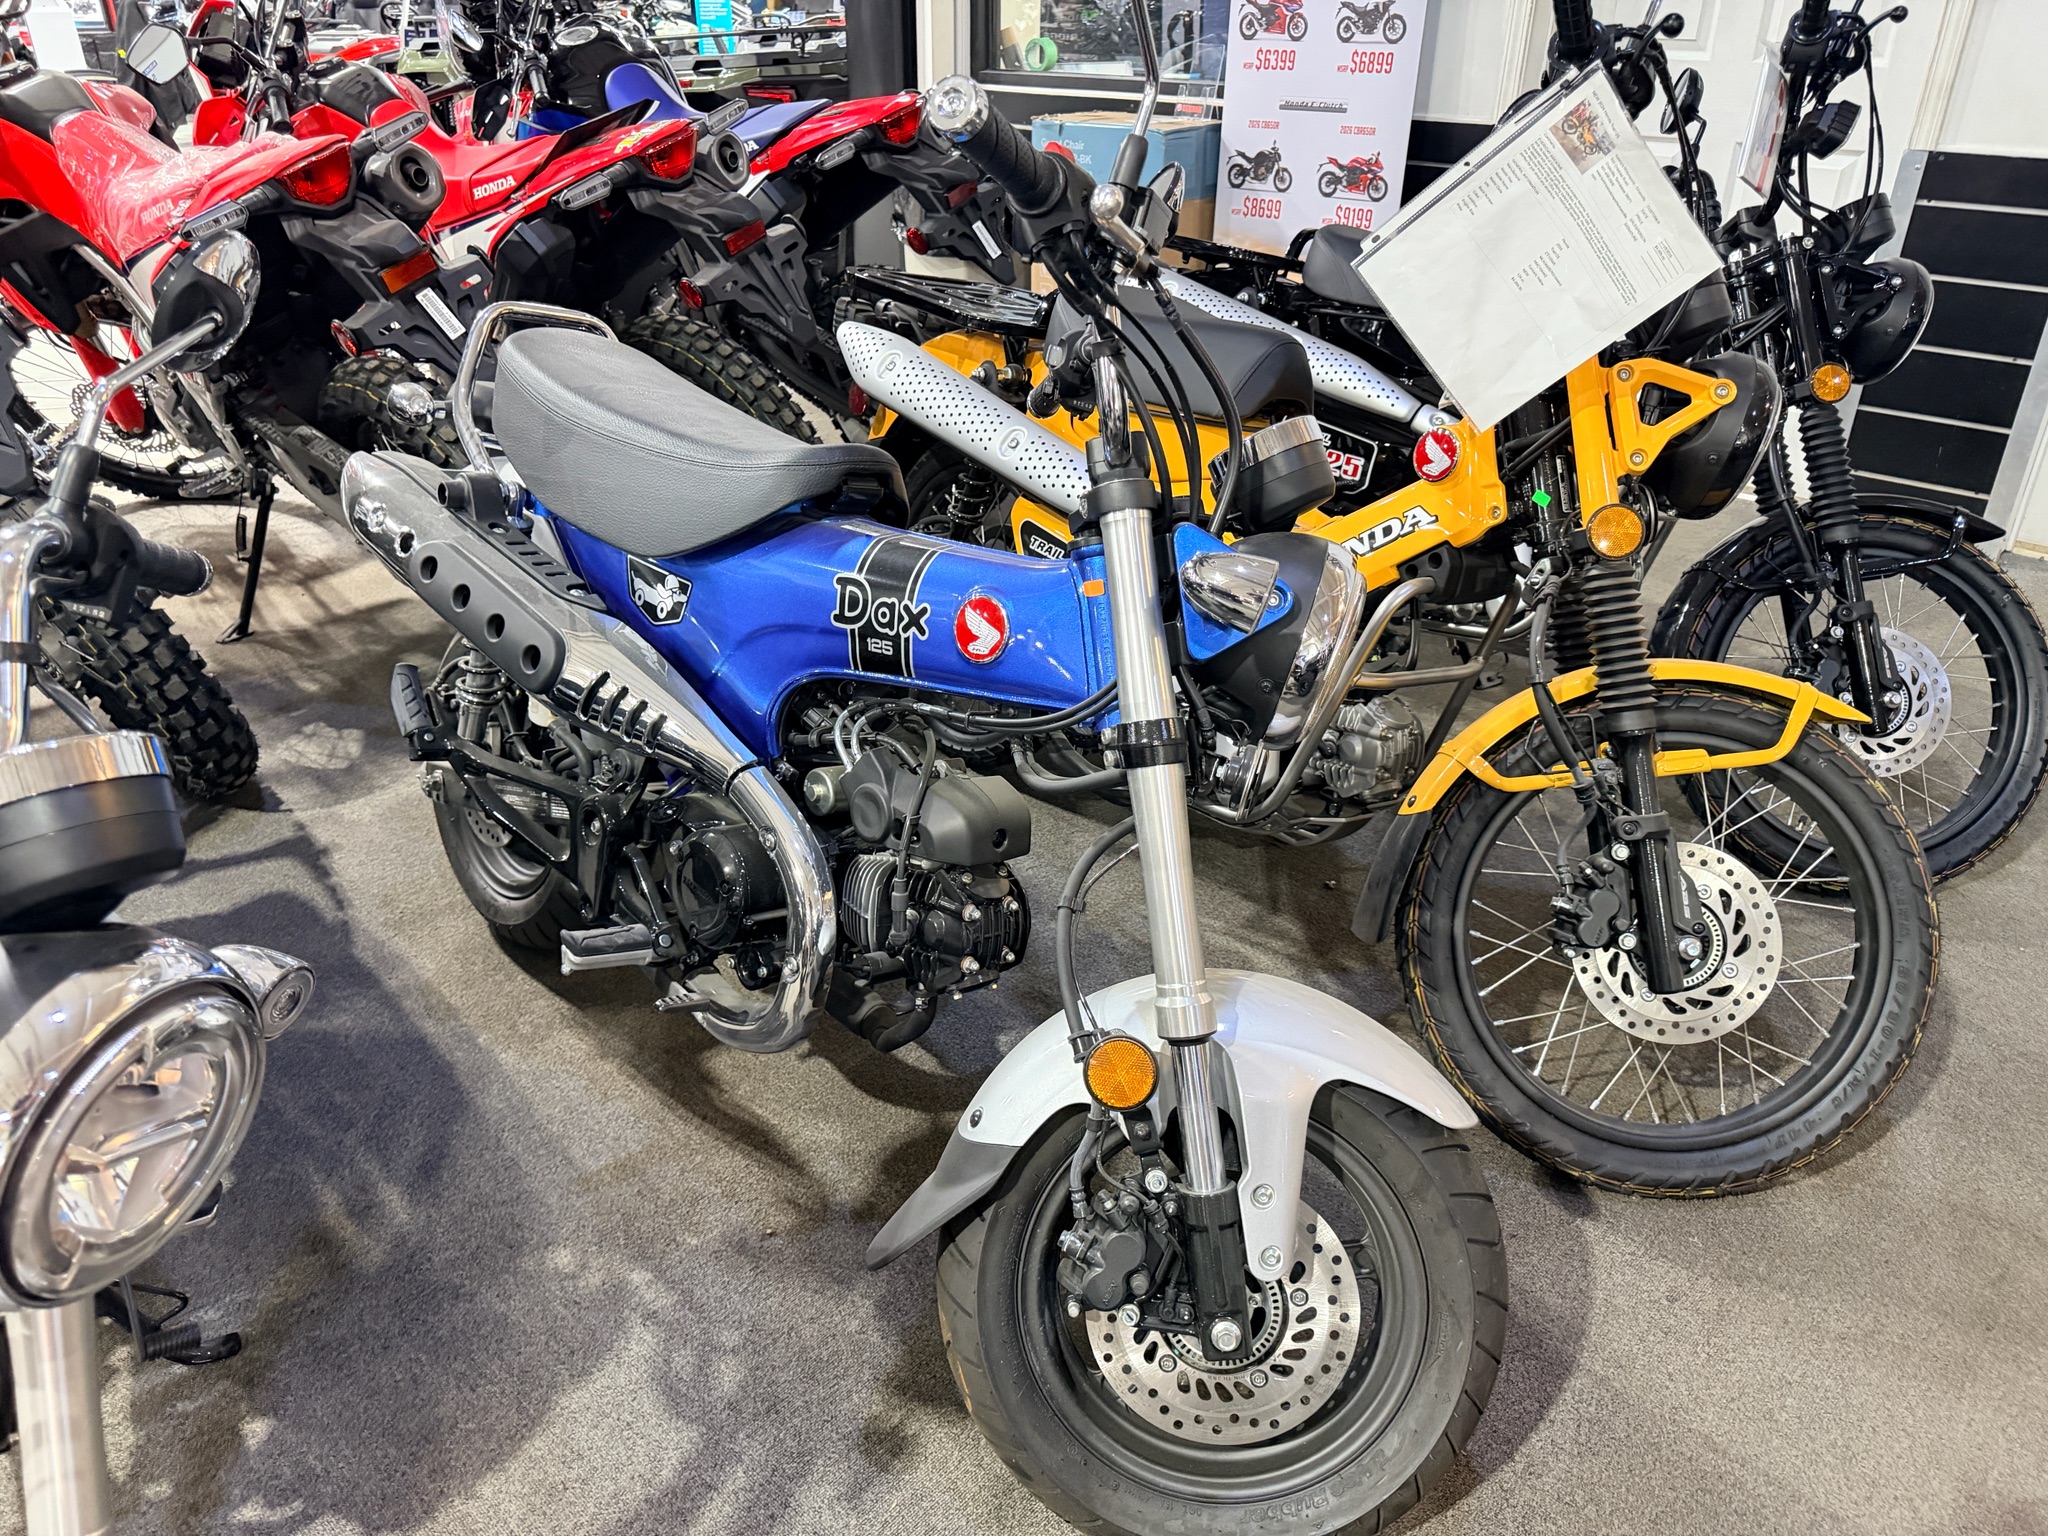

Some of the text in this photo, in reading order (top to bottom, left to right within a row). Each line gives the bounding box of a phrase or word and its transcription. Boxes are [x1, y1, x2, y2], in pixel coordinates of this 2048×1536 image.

[1255, 47, 1296, 72] $6399
[1336, 49, 1394, 75] MSRP $6899
[1284, 100, 1344, 109] Honda E-Clutch
[473, 175, 517, 200] HONDA
[140, 198, 175, 226] HONDA
[1242, 195, 1282, 220] $8699
[1334, 204, 1373, 229] $9199
[1326, 448, 1365, 481] 25
[1341, 505, 1439, 558] NDA
[830, 573, 931, 641] Dax
[866, 637, 893, 656] 125
[1678, 873, 1692, 920] ABS
